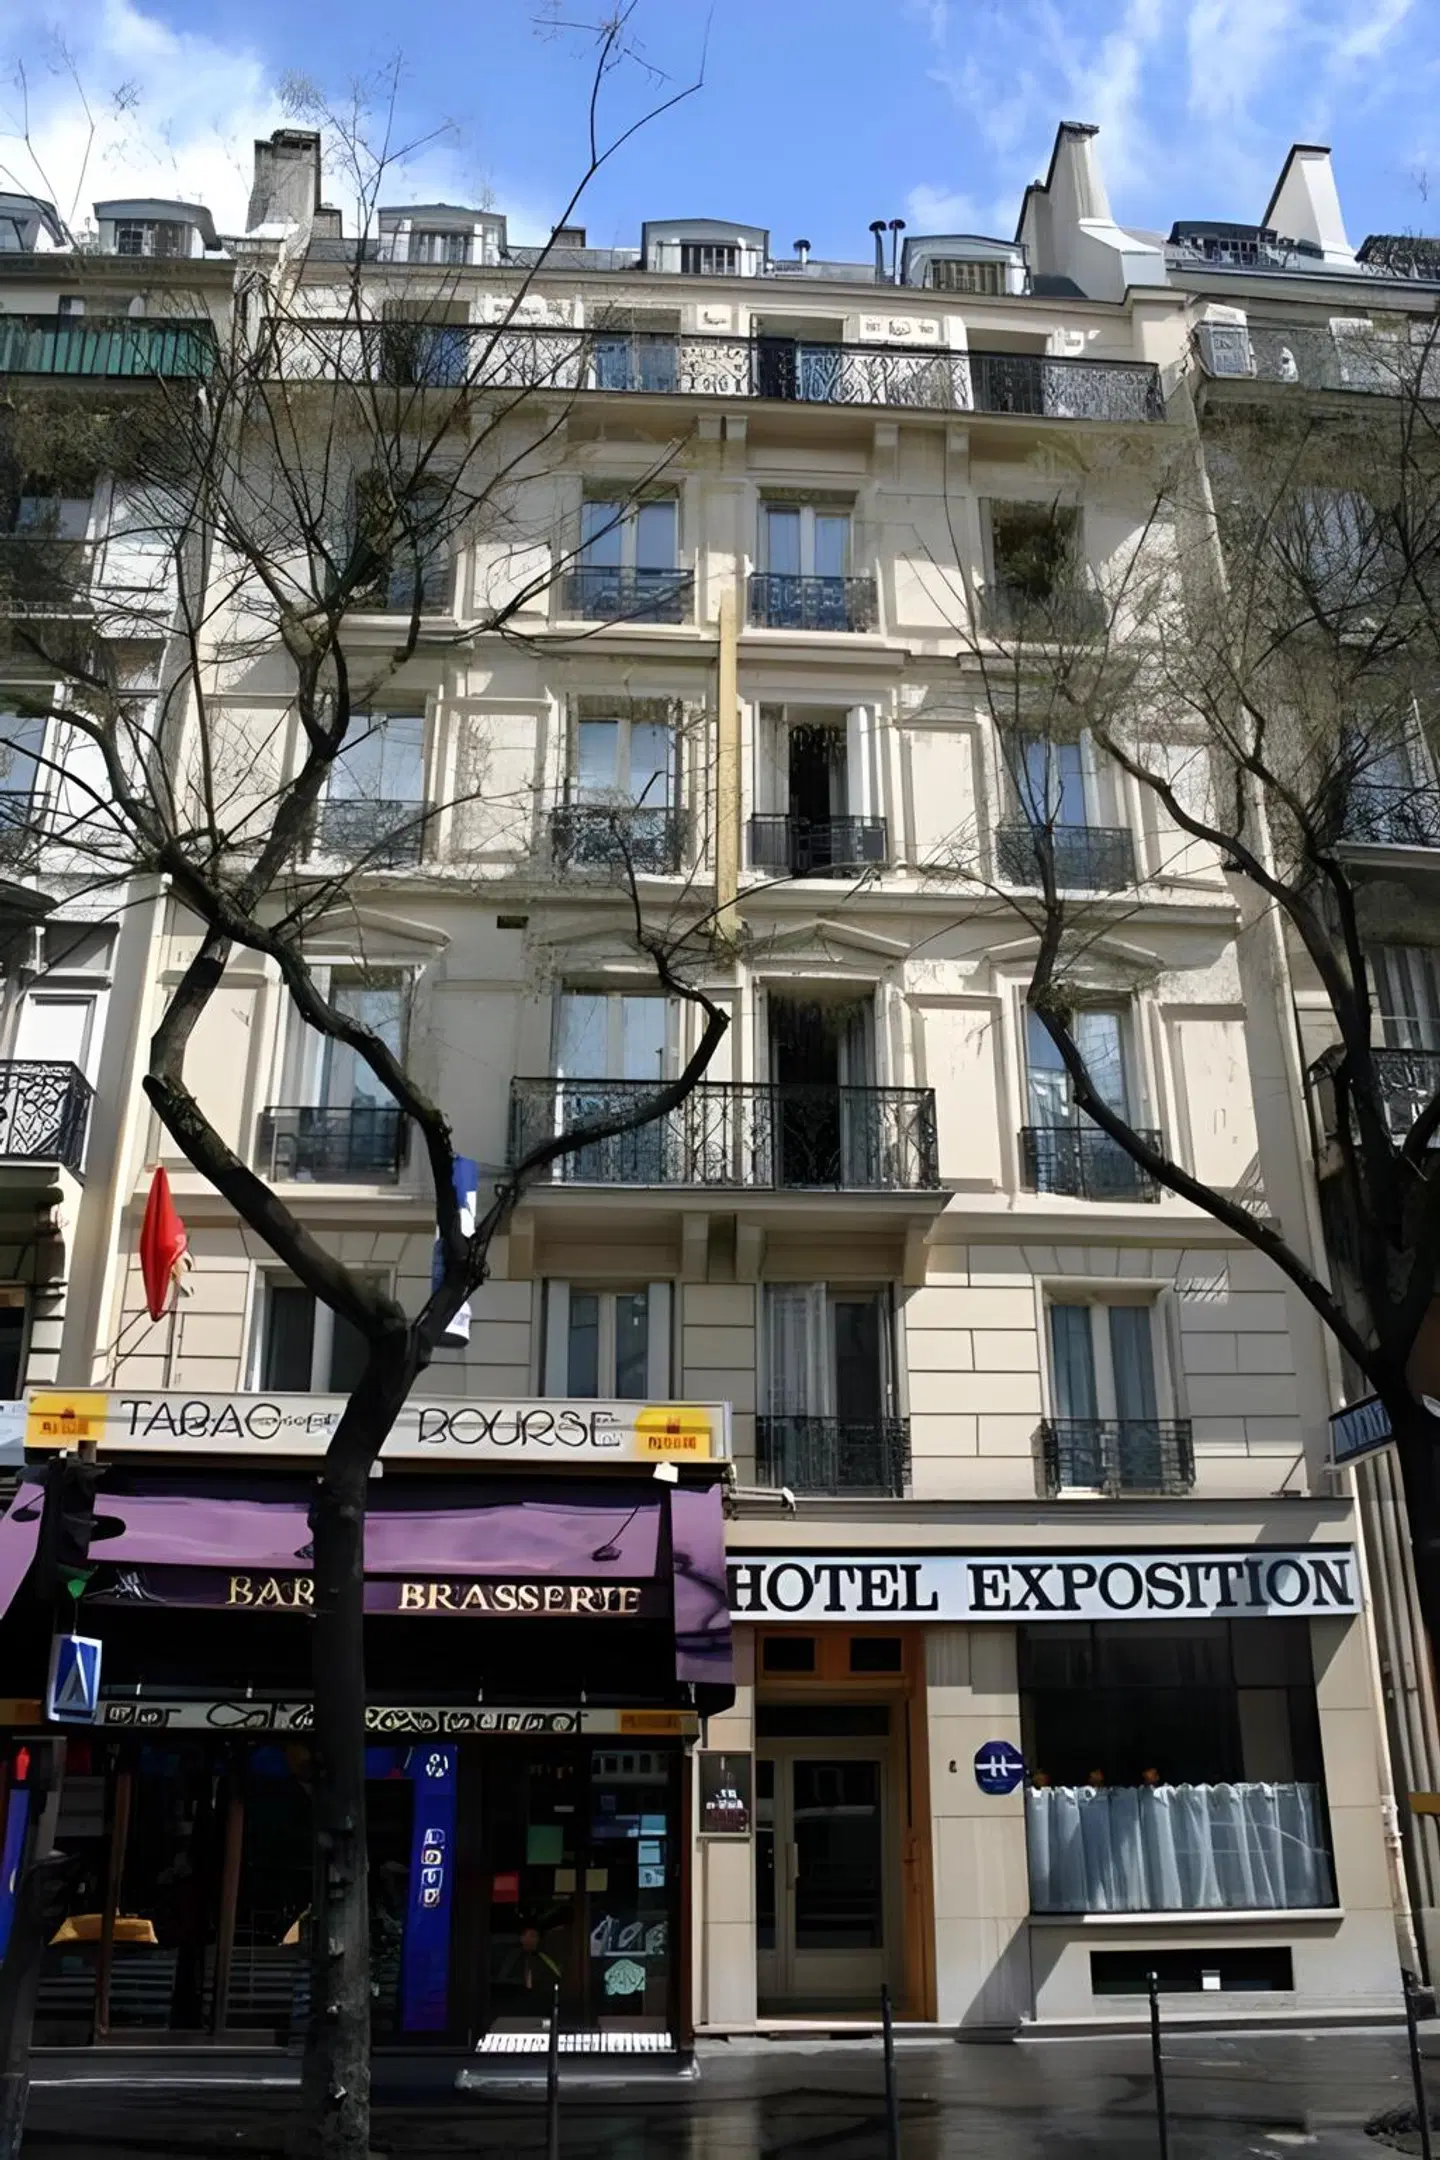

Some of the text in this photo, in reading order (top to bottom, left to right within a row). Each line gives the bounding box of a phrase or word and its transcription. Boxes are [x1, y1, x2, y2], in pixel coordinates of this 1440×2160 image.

[121, 1400, 281, 1440] TABAC
[418, 1408, 621, 1447] BOURSE
[225, 1576, 642, 1613] BAR BRASSERIE
[726, 1557, 1355, 1613] HOTEL EXPOSITION
